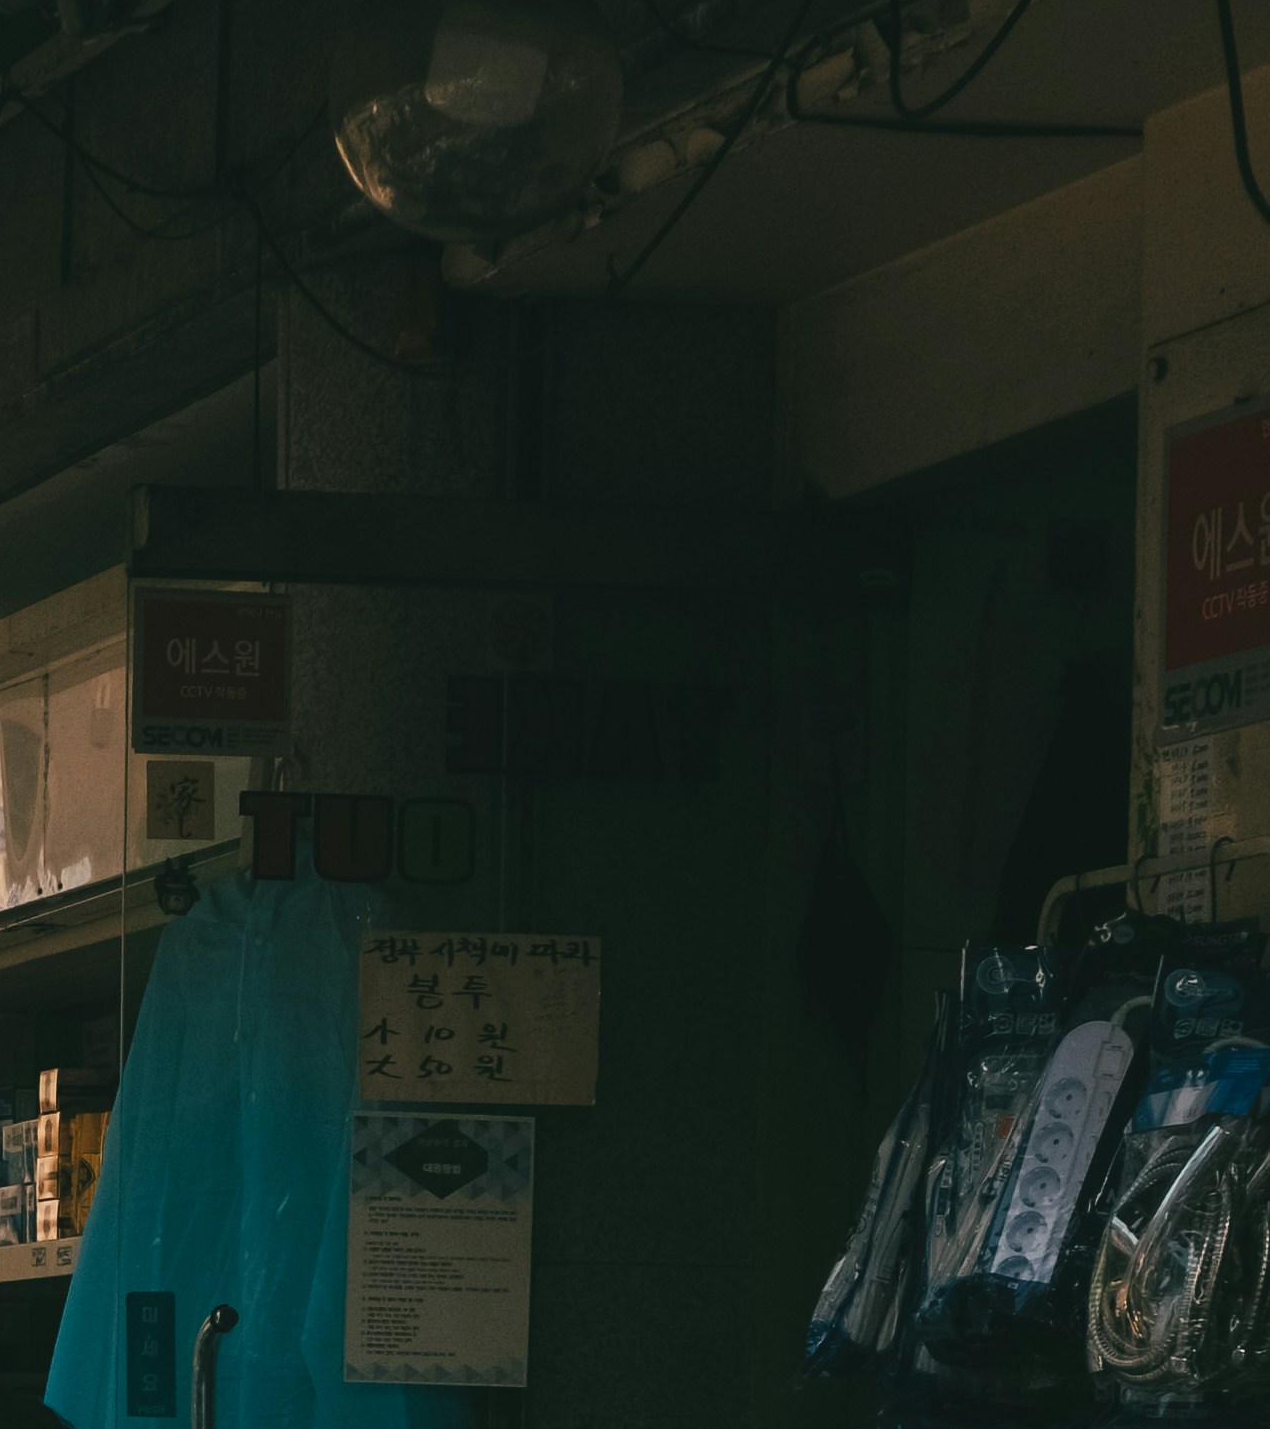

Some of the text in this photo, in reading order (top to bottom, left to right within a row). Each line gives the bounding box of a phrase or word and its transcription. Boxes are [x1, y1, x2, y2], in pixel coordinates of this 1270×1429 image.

[1201, 593, 1234, 621] CCTV
[166, 637, 260, 677] 에스원
[179, 684, 212, 700] CCTV
[1164, 669, 1242, 726] SECOM
[142, 726, 224, 749] SECOM
[362, 936, 422, 966] 정부
[424, 1024, 456, 1045] 10
[416, 1056, 452, 1080] 50
